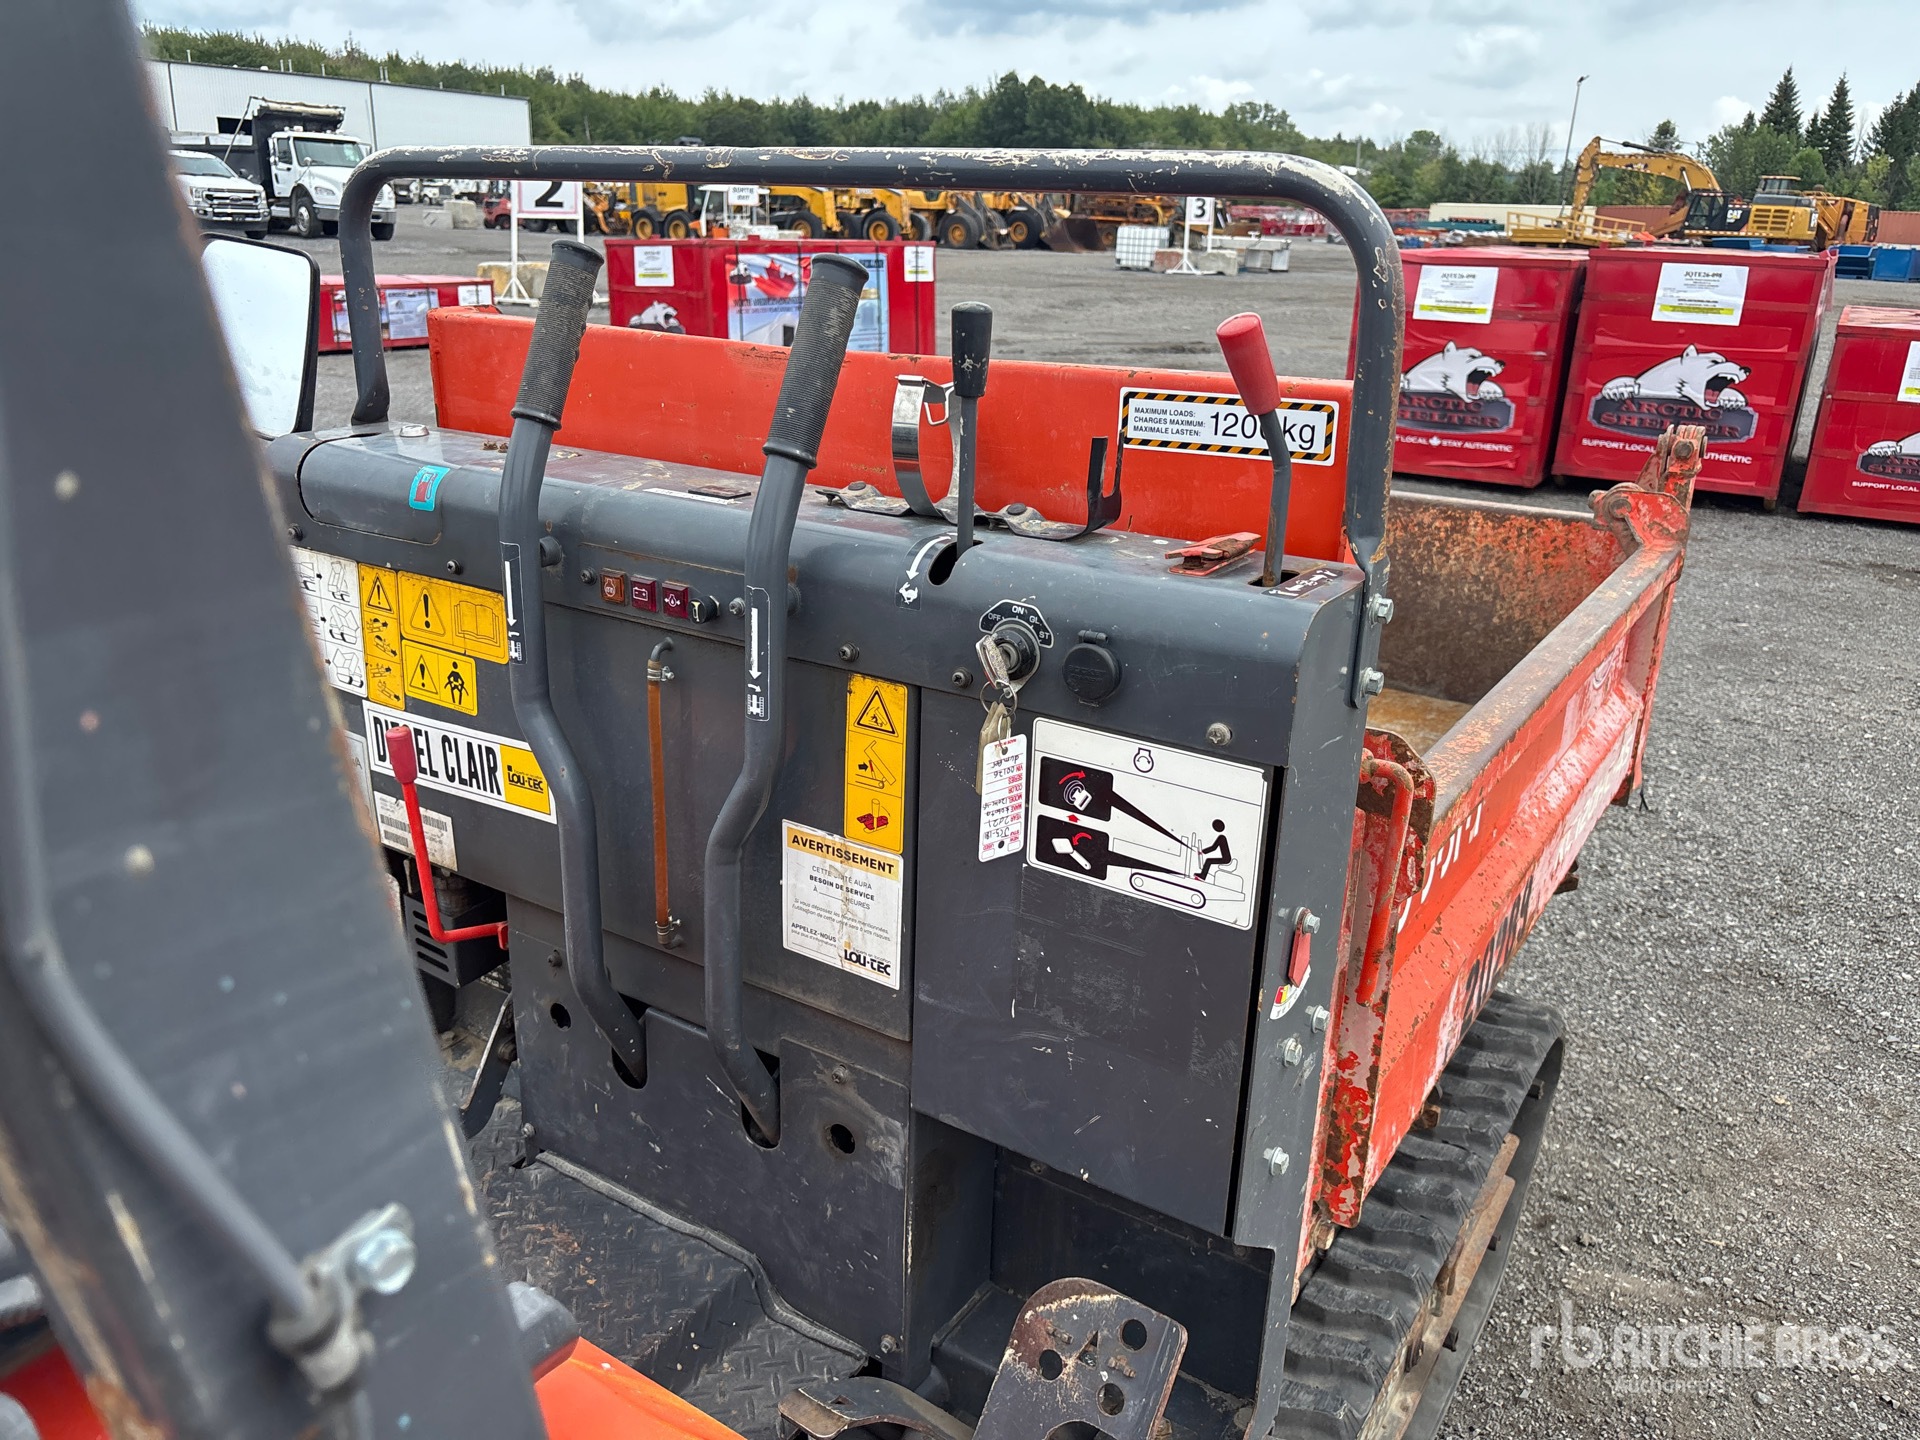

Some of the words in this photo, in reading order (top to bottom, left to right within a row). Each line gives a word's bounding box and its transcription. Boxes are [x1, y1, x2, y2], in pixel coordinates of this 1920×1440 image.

[1194, 198, 1206, 218] 3
[1727, 210, 1742, 220] CAT
[1134, 406, 1168, 417] MAXIMUM
[1169, 409, 1196, 418] LOADS:
[1620, 399, 1723, 420] ARCTIC
[1133, 416, 1168, 425] CHARGES
[1169, 418, 1206, 428] MAXIMUM:
[1133, 426, 1170, 435] MAXIMALE
[1171, 429, 1201, 437] LASTEN:
[1210, 411, 1266, 441] 120
[1283, 416, 1316, 450] kg
[1400, 435, 1428, 445] LOCAL
[1442, 439, 1462, 448] STAY
[1463, 441, 1513, 453] AUTHENTIC
[1581, 438, 1624, 450] SUPPORT
[1703, 452, 1753, 464] UTHENTIC
[1852, 481, 1890, 491] SUPPORT
[1891, 484, 1919, 493] LOCAL
[1012, 605, 1025, 615] ON
[988, 612, 1001, 622] OFF
[1038, 631, 1050, 640] ST
[441, 734, 502, 796] CLAIR
[792, 835, 894, 874] AVERTISSEMENT
[811, 865, 831, 877] CETTE
[853, 879, 873, 890] AURA
[810, 874, 834, 888] BESOIN
[835, 883, 845, 891] DE
[846, 886, 875, 902] SERVICE
[846, 896, 870, 910] HEURES
[791, 922, 837, 943] APPELEZ-NOUS
